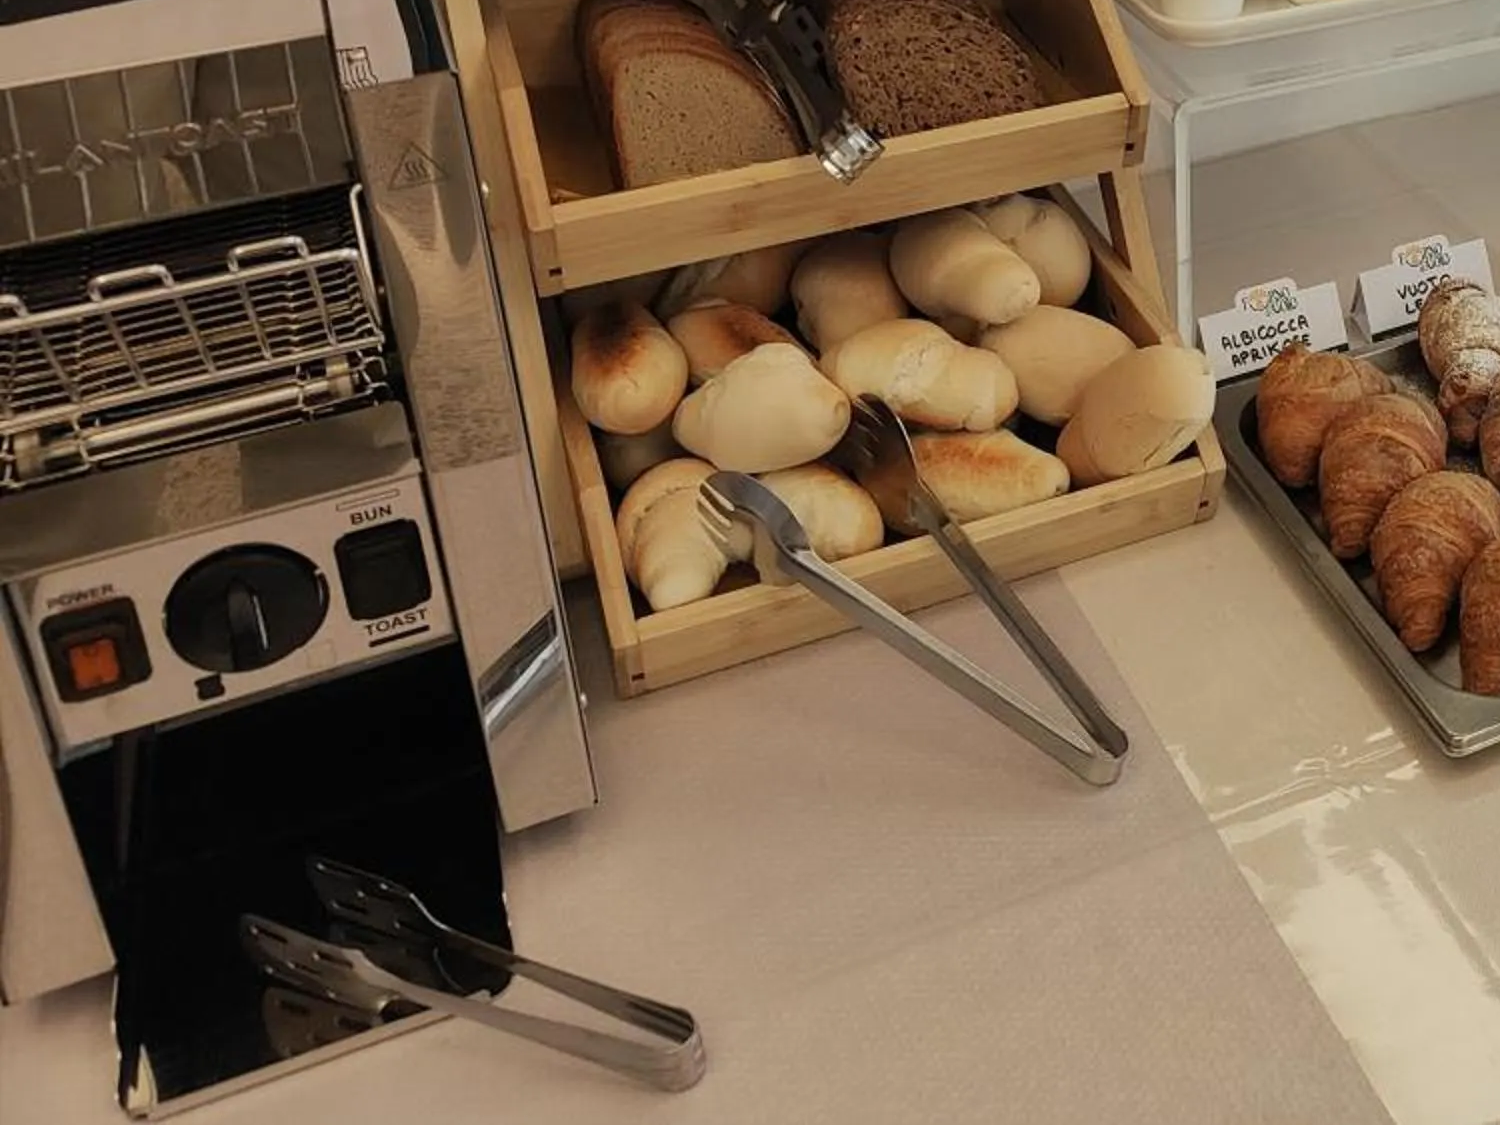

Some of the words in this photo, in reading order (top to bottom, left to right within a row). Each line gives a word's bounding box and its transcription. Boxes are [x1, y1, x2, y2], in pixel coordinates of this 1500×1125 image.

[1221, 314, 1310, 351] ALBICOCCA
[350, 504, 393, 525] BUN
[365, 607, 428, 636] TOAST
